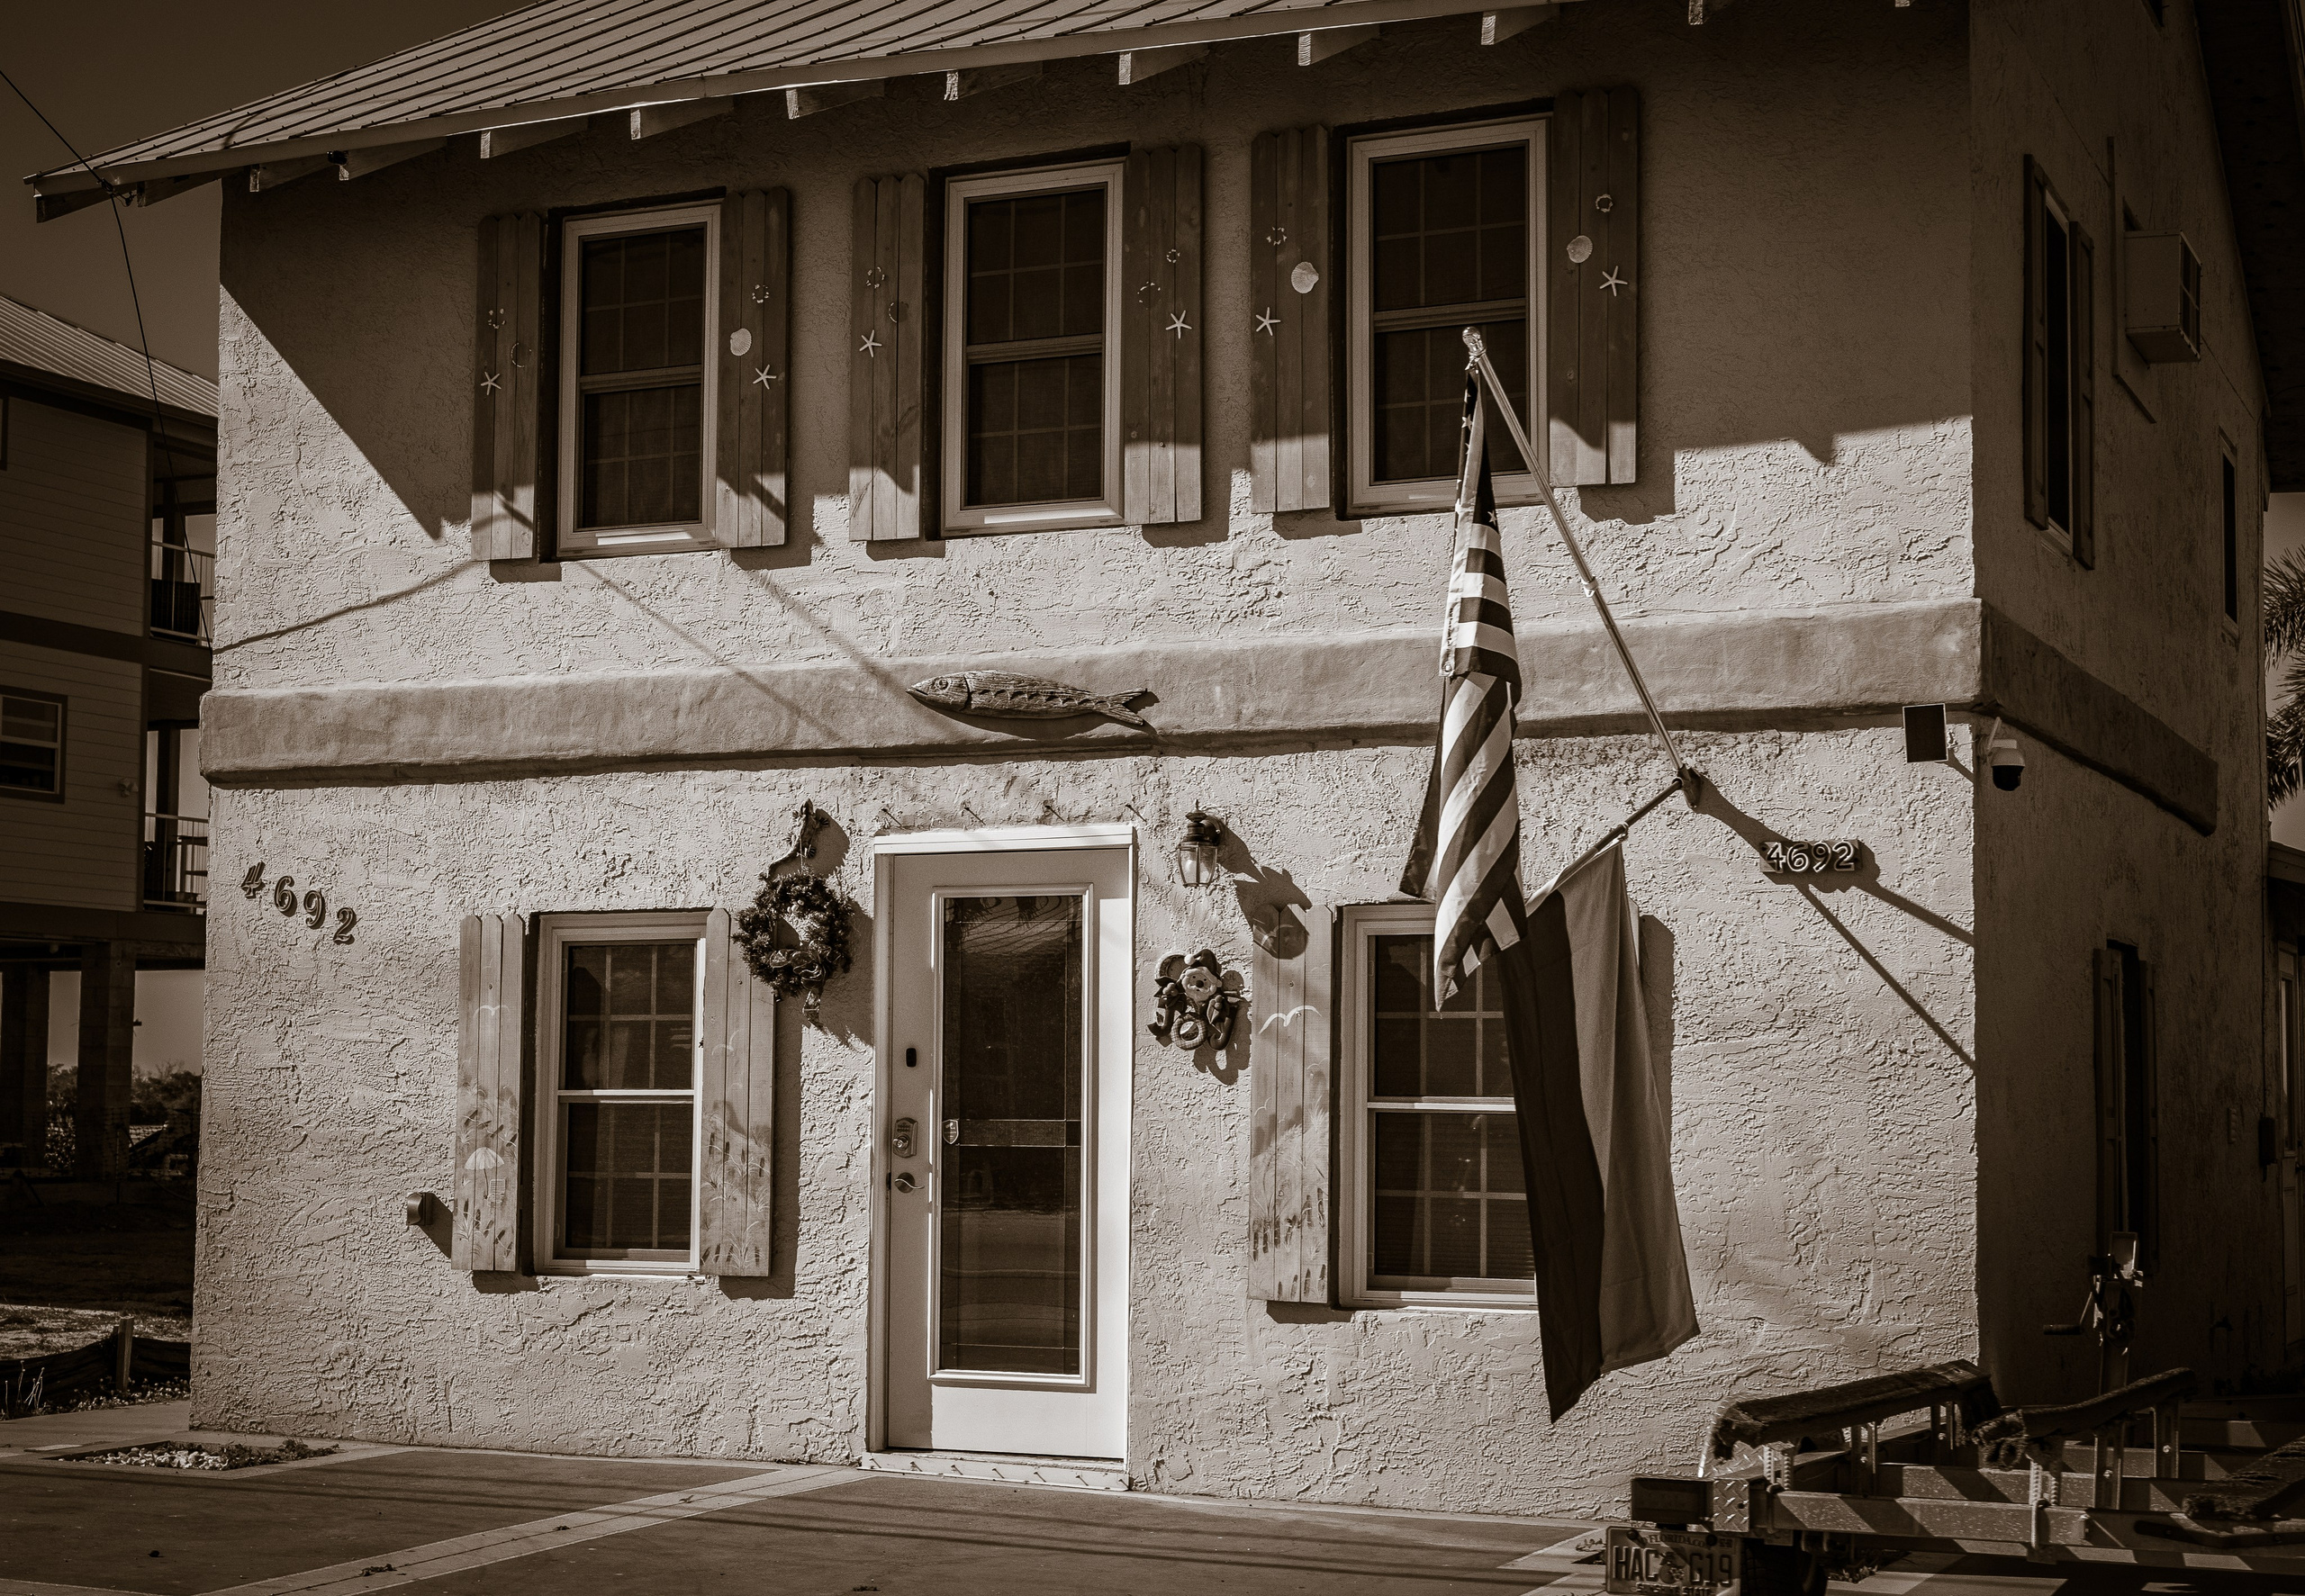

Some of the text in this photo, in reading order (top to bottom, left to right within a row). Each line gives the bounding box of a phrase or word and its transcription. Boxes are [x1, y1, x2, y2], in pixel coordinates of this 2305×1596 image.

[1767, 842, 1856, 873] 4692
[240, 861, 356, 944] 4692
[1613, 1546, 1660, 1582] HAC
